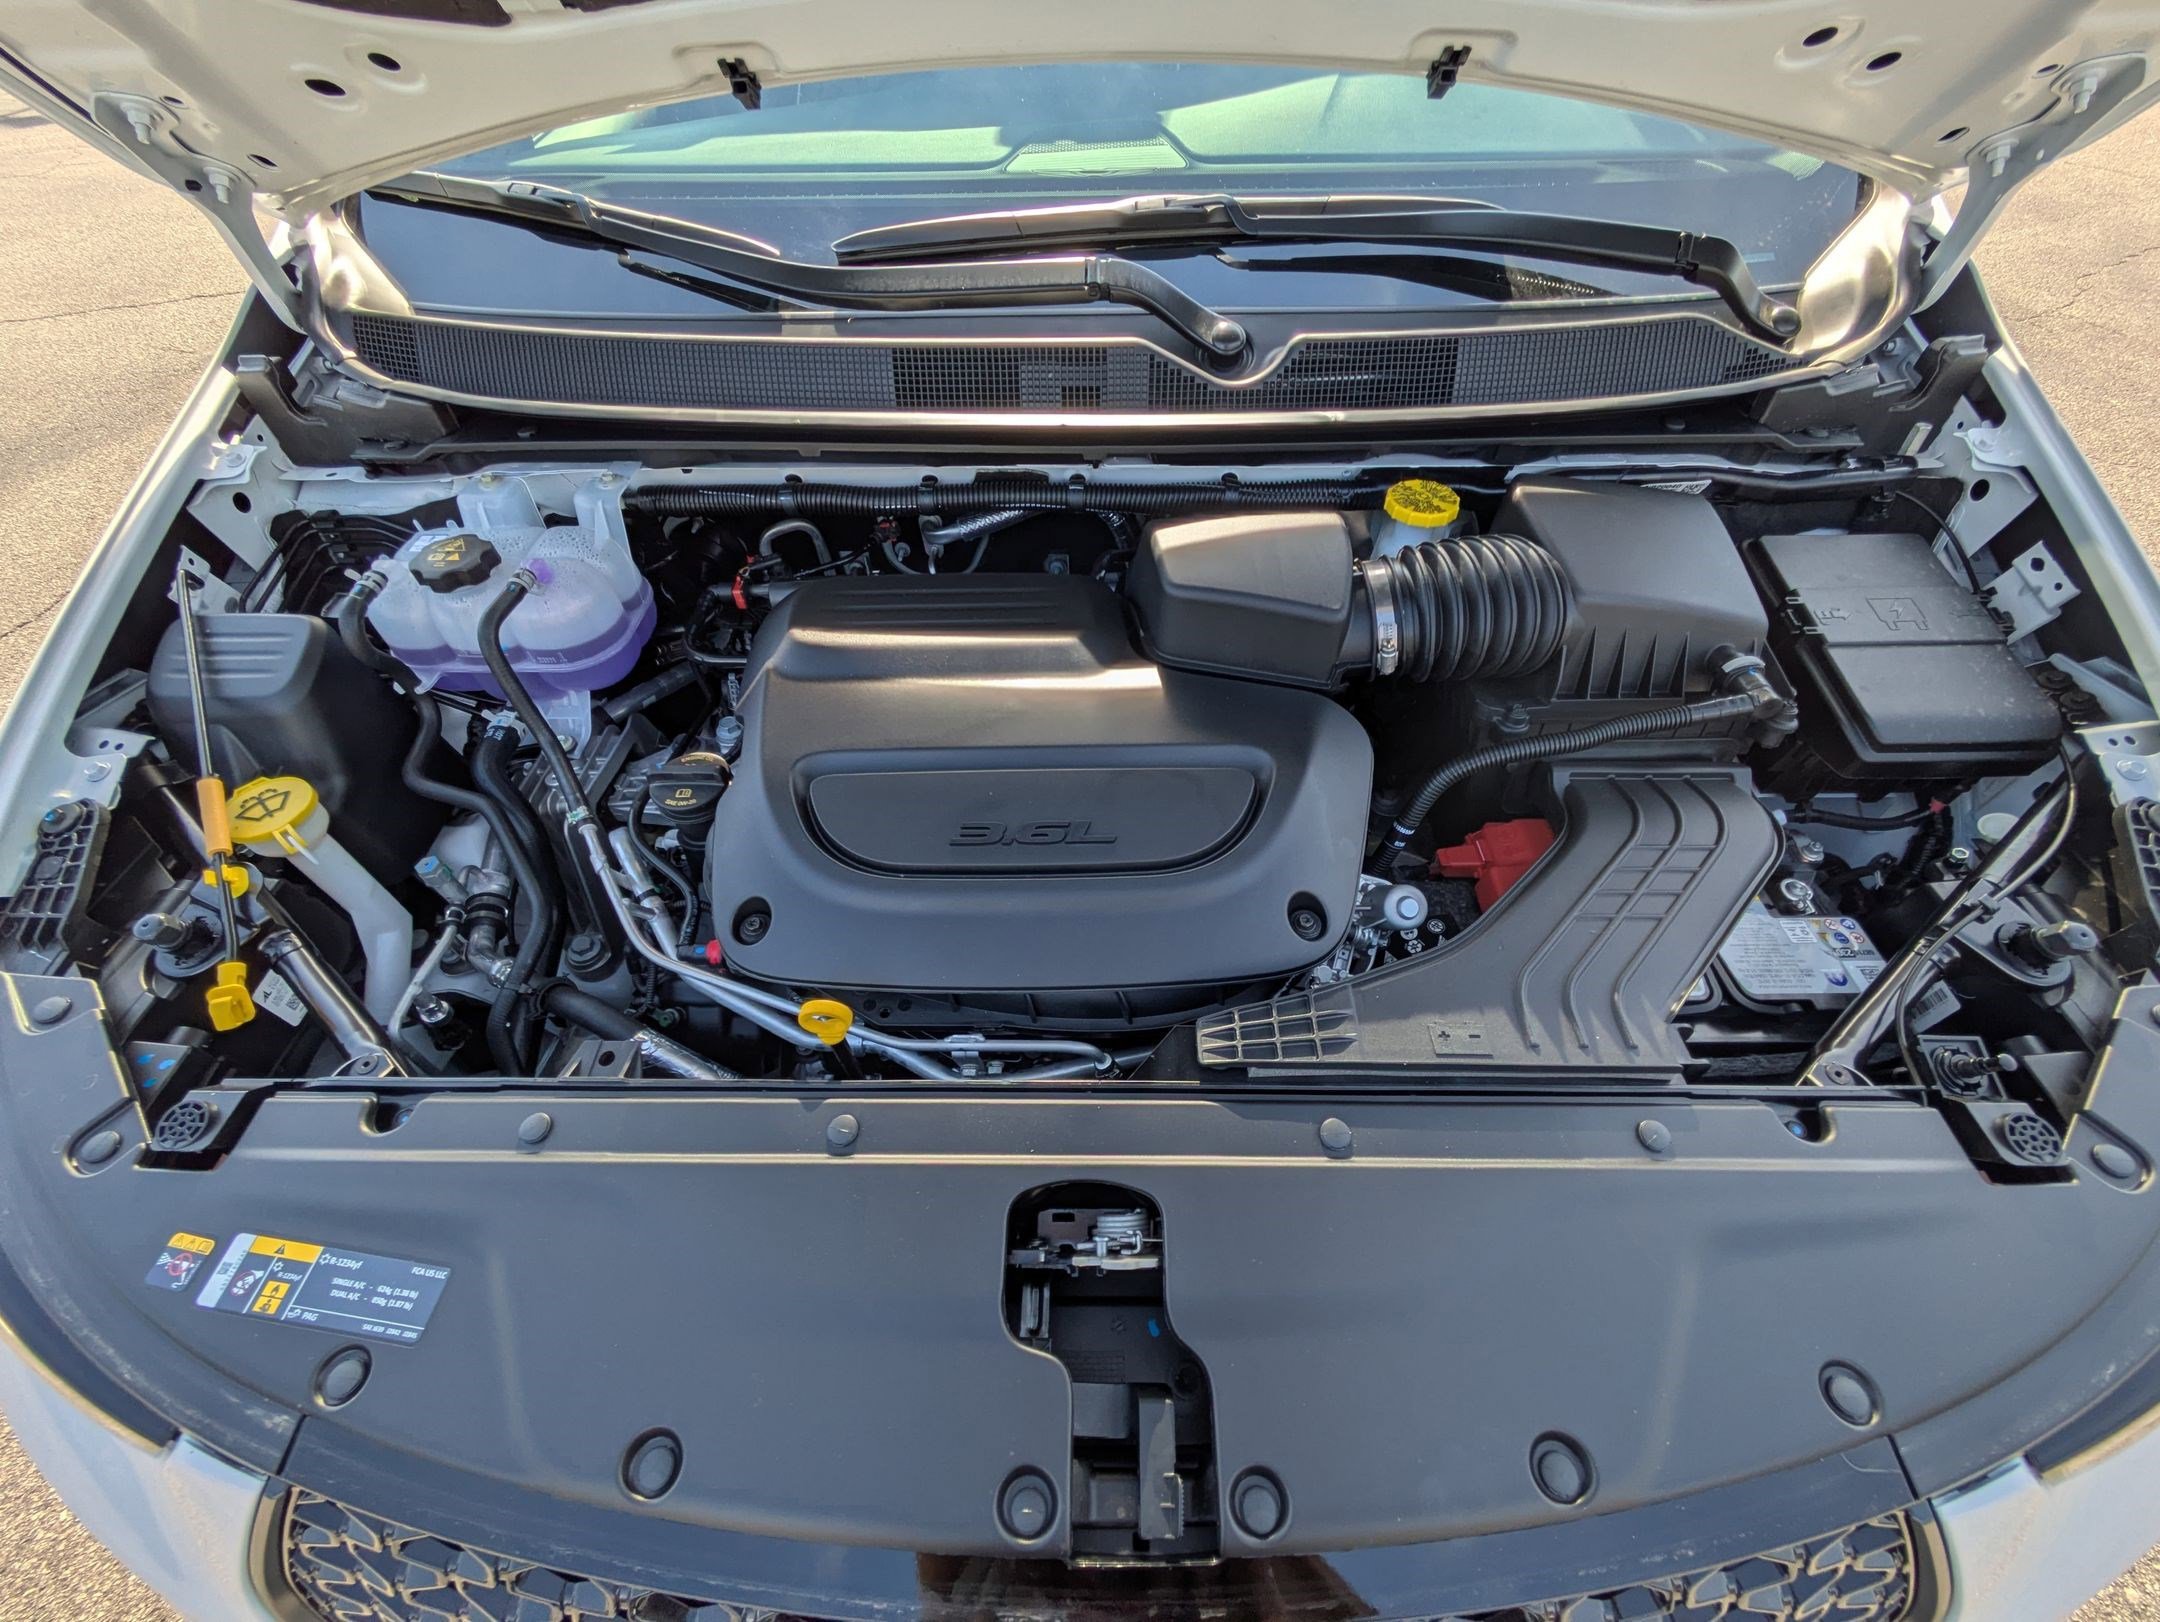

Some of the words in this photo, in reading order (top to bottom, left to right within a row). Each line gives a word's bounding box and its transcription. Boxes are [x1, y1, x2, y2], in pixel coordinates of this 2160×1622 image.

[948, 820, 1118, 846] 3.6L
[329, 1257, 364, 1270] R-1234yf
[411, 1266, 425, 1276] FCA
[425, 1268, 436, 1278] US
[435, 1270, 448, 1279] LLC
[331, 1277, 354, 1287] SINGLE
[353, 1280, 367, 1289] A/C
[330, 1289, 349, 1299] DUAL
[348, 1292, 361, 1301] A/C
[301, 1312, 319, 1321] PAG
